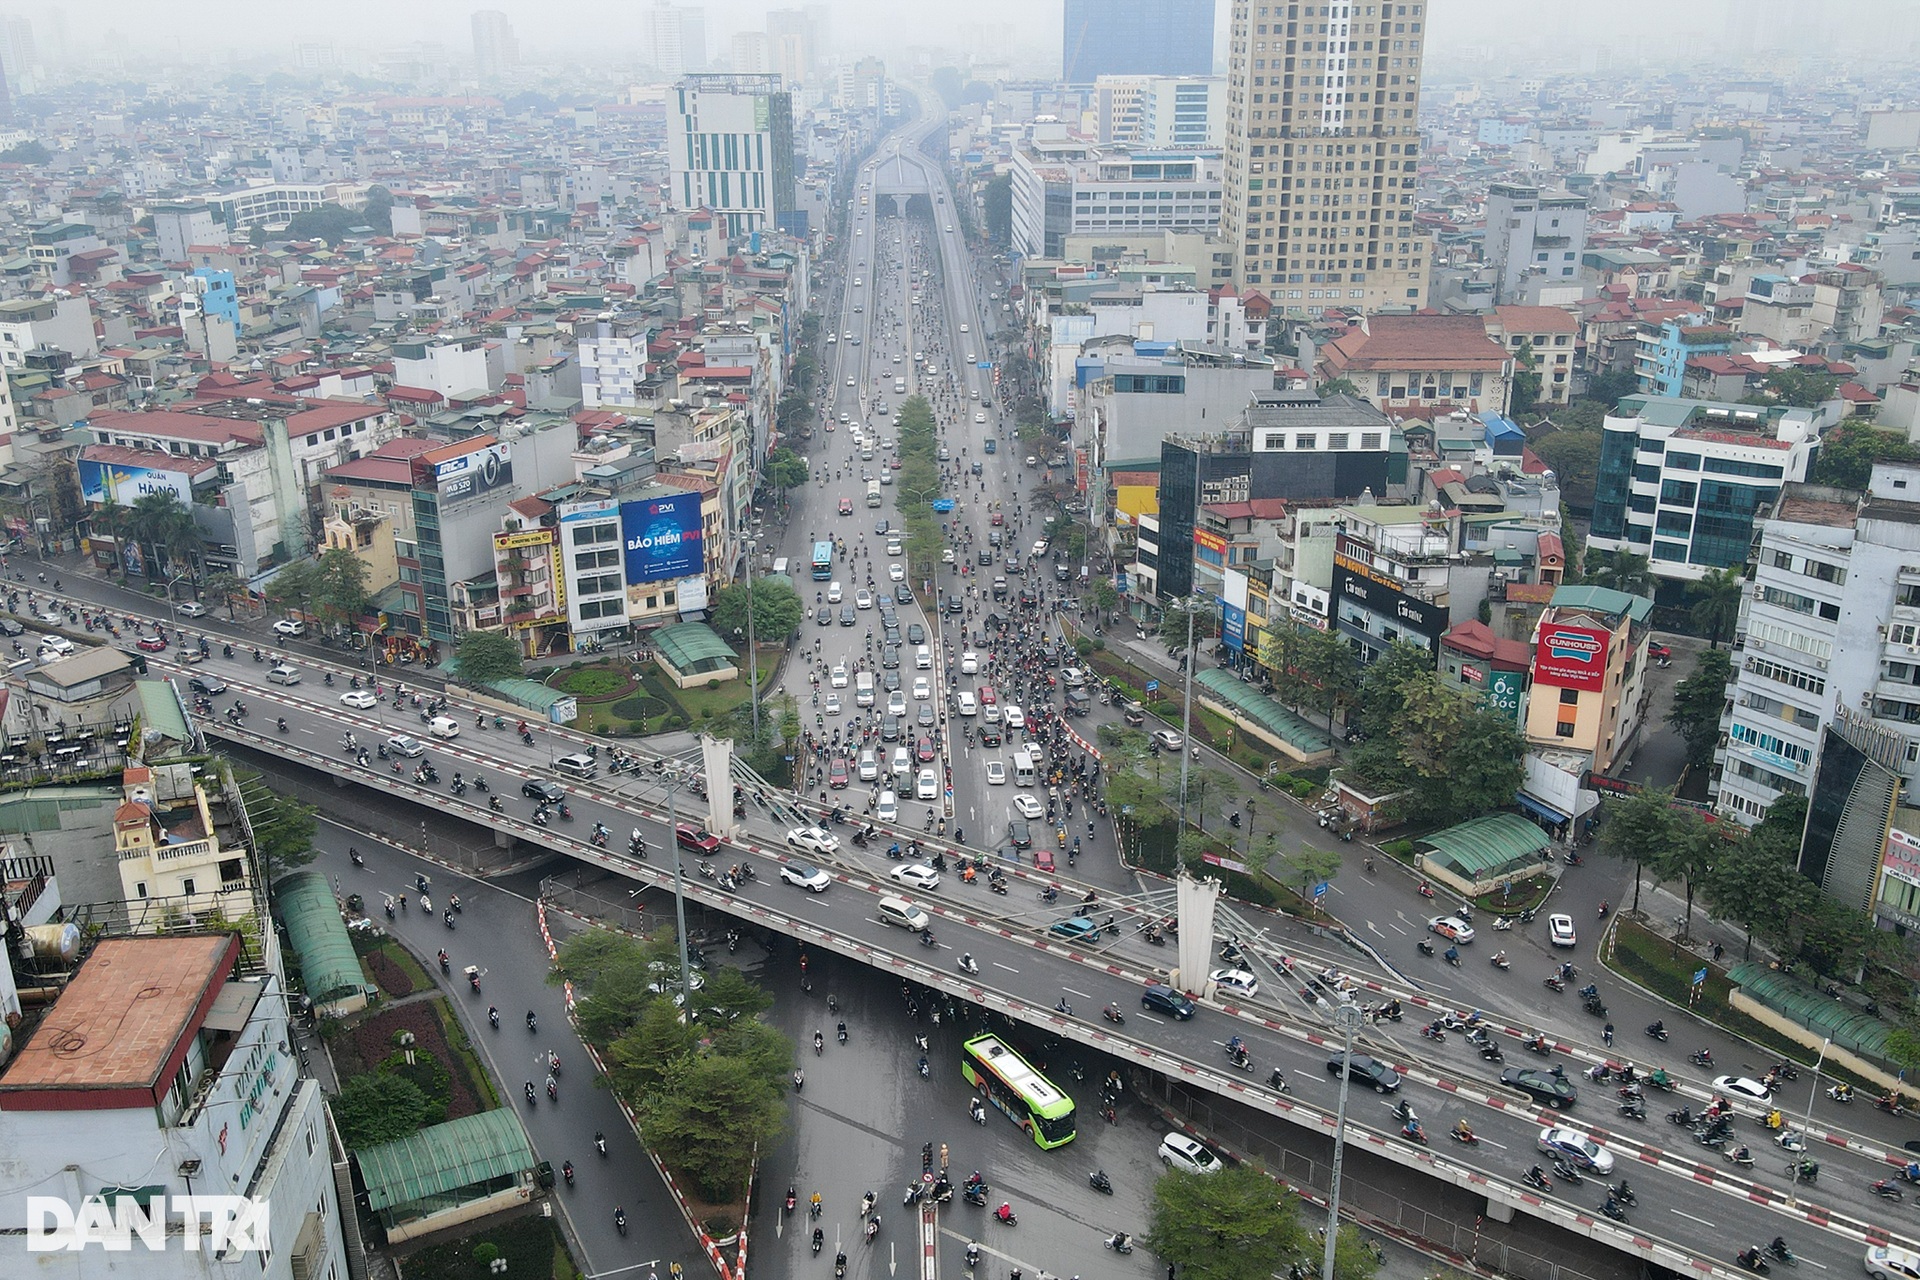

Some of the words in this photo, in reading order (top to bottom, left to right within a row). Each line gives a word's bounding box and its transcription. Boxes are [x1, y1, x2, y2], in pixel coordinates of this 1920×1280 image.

[627, 535, 652, 551] BẢO
[654, 529, 681, 546] HIỂM
[682, 530, 700, 542] PVI
[1550, 638, 1597, 651] SUNHOUSE
[1494, 675, 1515, 695] Ốc
